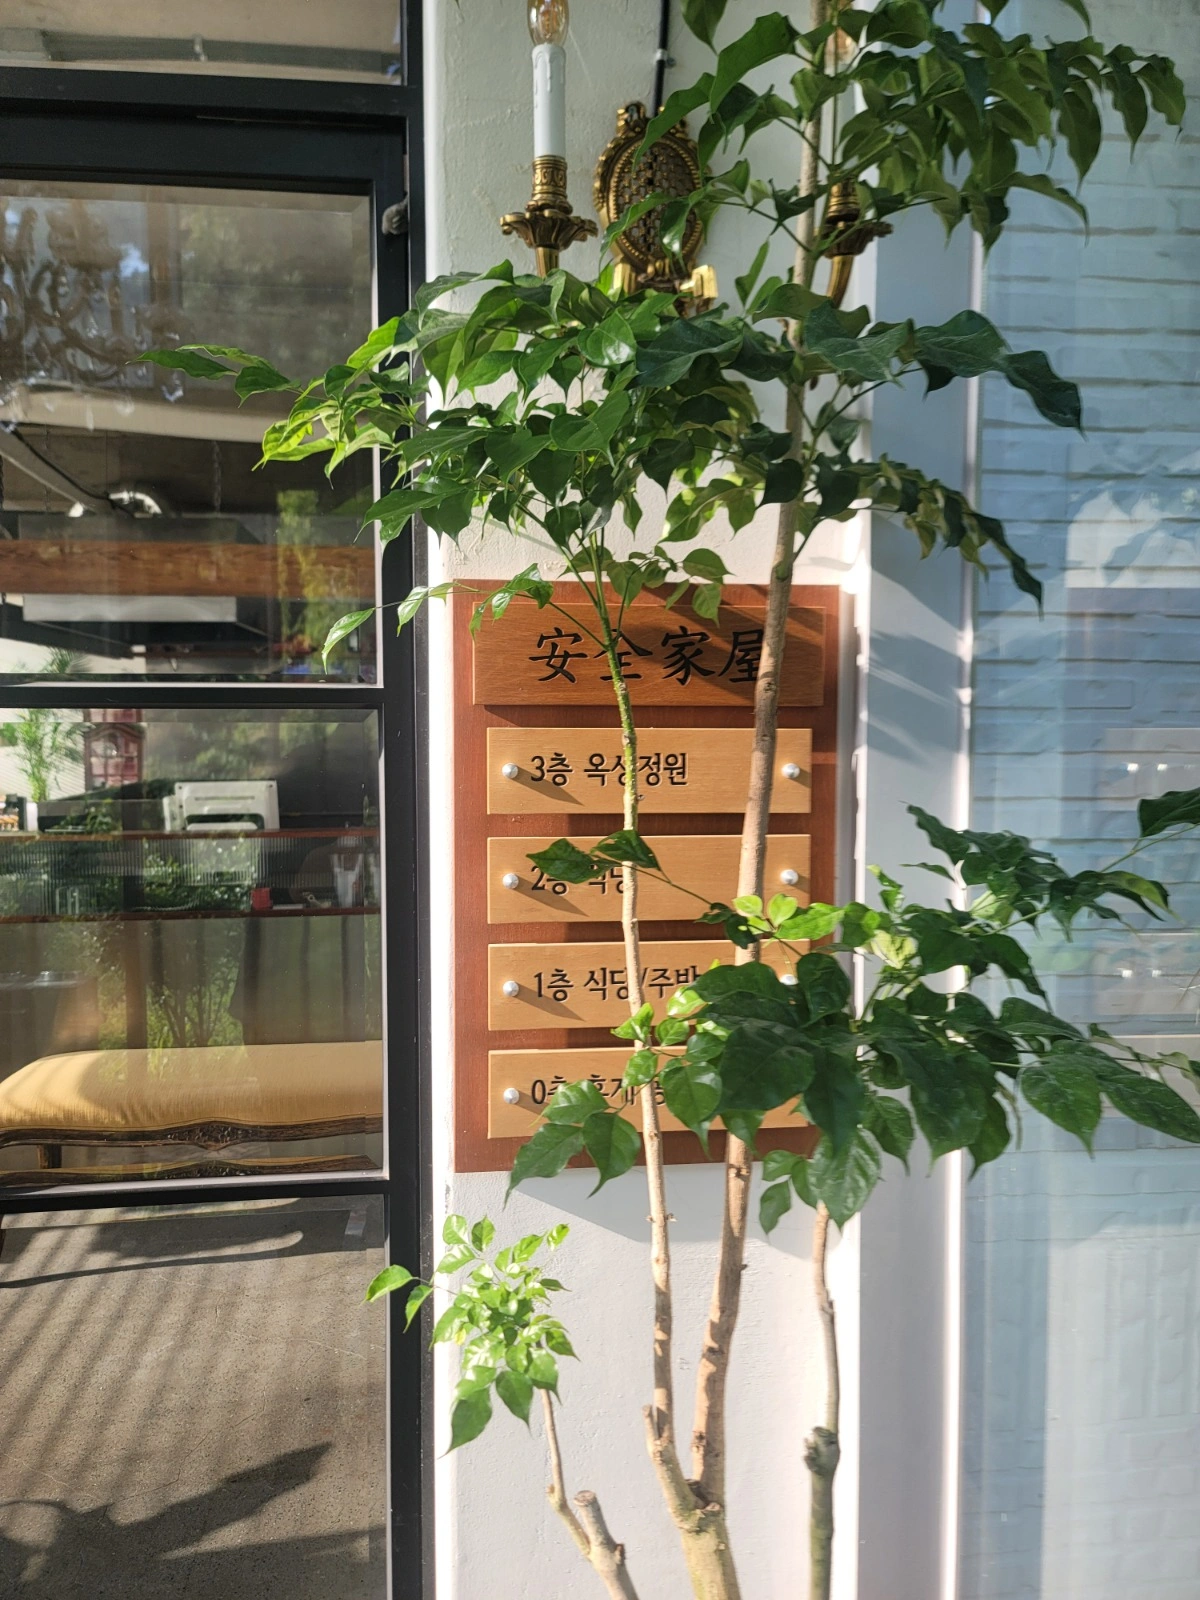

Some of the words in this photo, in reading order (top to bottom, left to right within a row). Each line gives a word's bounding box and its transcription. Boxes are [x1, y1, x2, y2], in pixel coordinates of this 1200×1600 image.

[528, 625, 765, 686] 安全家屋
[530, 752, 573, 787] 3층
[534, 968, 574, 1002] 1층
